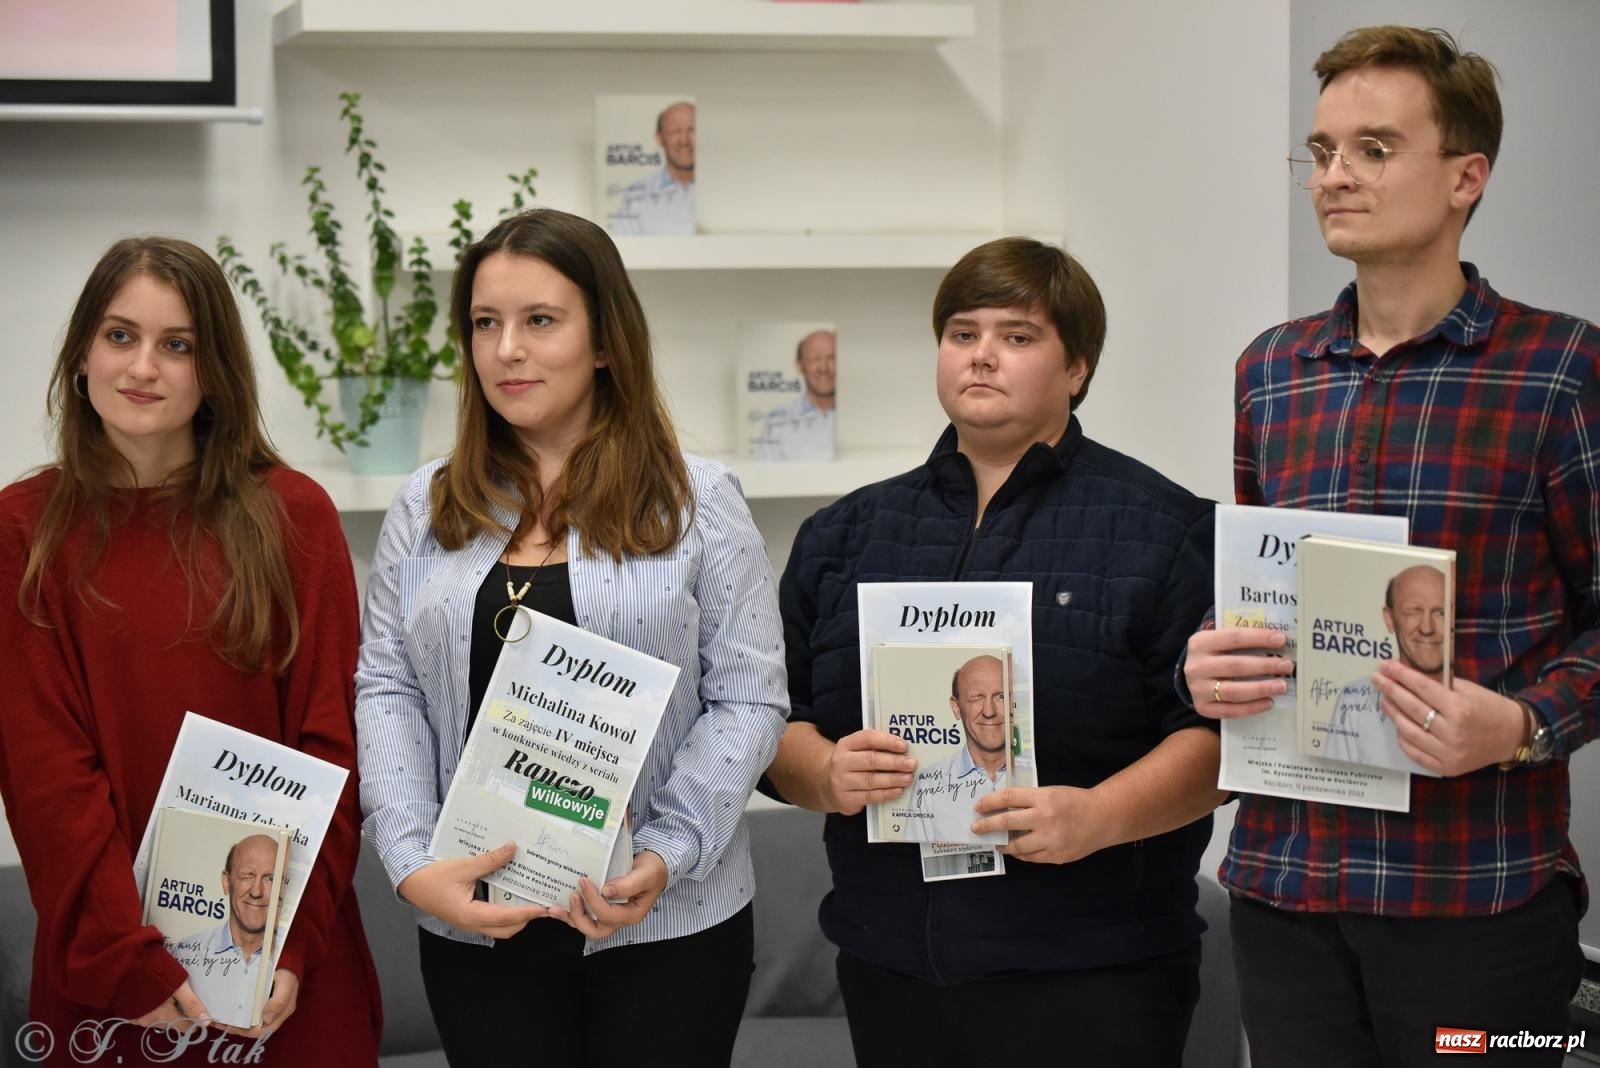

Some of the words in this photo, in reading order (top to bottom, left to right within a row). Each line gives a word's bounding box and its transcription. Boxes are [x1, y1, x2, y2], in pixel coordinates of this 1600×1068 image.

[1240, 586, 1297, 607] Bartos
[899, 603, 996, 632] Dyplom
[1312, 618, 1364, 636] ARTUR
[1312, 632, 1393, 660] BARCIŚ
[541, 643, 637, 698] Dyplom
[506, 681, 586, 724] Michalina
[589, 713, 637, 745] Kowol
[889, 714, 935, 727] ARTUR
[502, 709, 517, 724] Za
[518, 719, 552, 738] zajęcie
[554, 727, 574, 744] IV
[574, 738, 620, 765] miejsca
[501, 727, 549, 754] konkursie
[551, 748, 582, 769] wiedzy
[589, 766, 620, 785] serialu
[211, 749, 308, 801] Dyplom
[503, 748, 595, 801] Ranczo
[176, 785, 248, 821] Marianna
[531, 786, 604, 821] Wilkowyje
[160, 877, 204, 897] ARTUR
[157, 890, 226, 920] BARCIŚ
[178, 953, 200, 967] rać,
